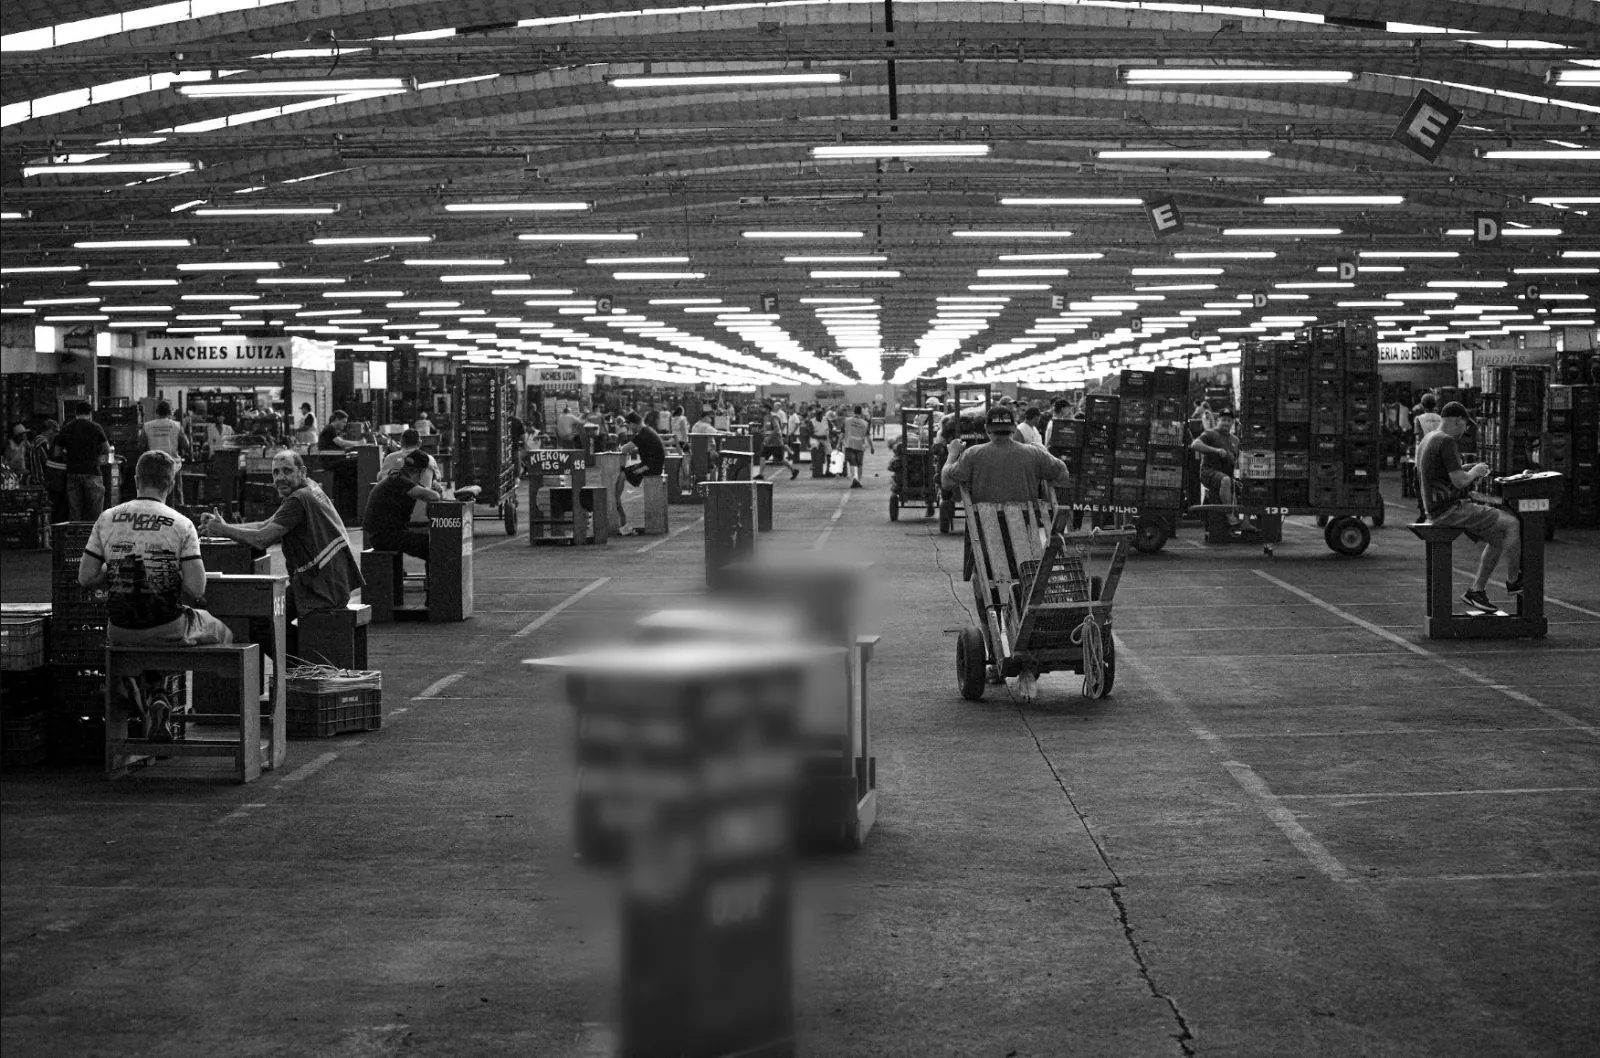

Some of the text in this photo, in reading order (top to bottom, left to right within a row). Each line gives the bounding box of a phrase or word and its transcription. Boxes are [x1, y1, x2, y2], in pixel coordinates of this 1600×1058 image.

[1406, 103, 1450, 149] E
[1152, 203, 1177, 231] E
[1478, 217, 1498, 241] D
[1340, 262, 1356, 280] D
[1527, 285, 1538, 299] C
[597, 298, 611, 312] G
[764, 297, 776, 312] F
[1052, 295, 1064, 310] E
[1254, 293, 1267, 308] D
[1131, 319, 1141, 330] D
[152, 345, 286, 360] LANCHES LUIZA
[1378, 347, 1398, 361] ERIA
[1411, 347, 1440, 361] EDISON
[530, 451, 570, 465] KIEKOW
[1109, 505, 1138, 514] FILHO
[112, 512, 175, 528] LOWCARS
